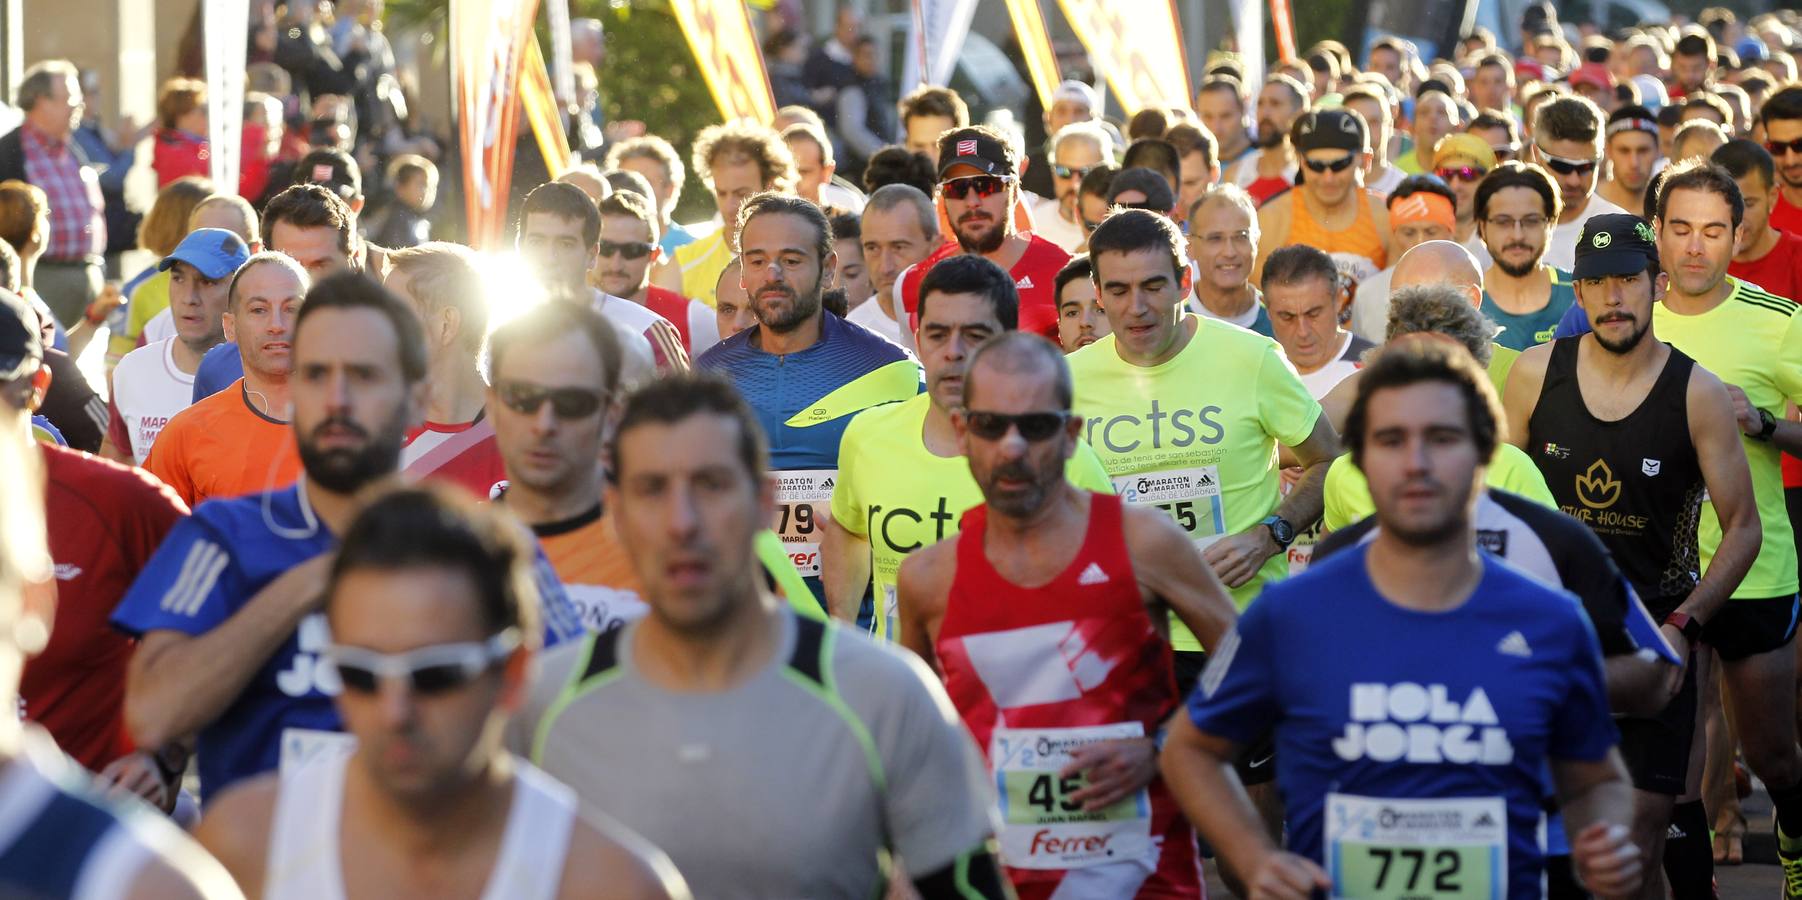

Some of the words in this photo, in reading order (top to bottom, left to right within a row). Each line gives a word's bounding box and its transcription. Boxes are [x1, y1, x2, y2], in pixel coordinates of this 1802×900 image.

[1086, 399, 1225, 454] rctss
[1107, 464, 1136, 473] ostiako
[1120, 456, 1131, 464] de
[1133, 454, 1153, 462] tenis
[1155, 452, 1167, 460] de
[1168, 451, 1185, 459] san
[776, 477, 813, 485] ARATÓN
[1169, 492, 1178, 500] DE
[868, 496, 962, 553] rct
[1560, 505, 1593, 523] ATUR
[1597, 510, 1649, 528] HOUSE
[1350, 681, 1500, 725] HOLA
[1331, 721, 1515, 765] JORGE
[1369, 848, 1461, 892] 772
